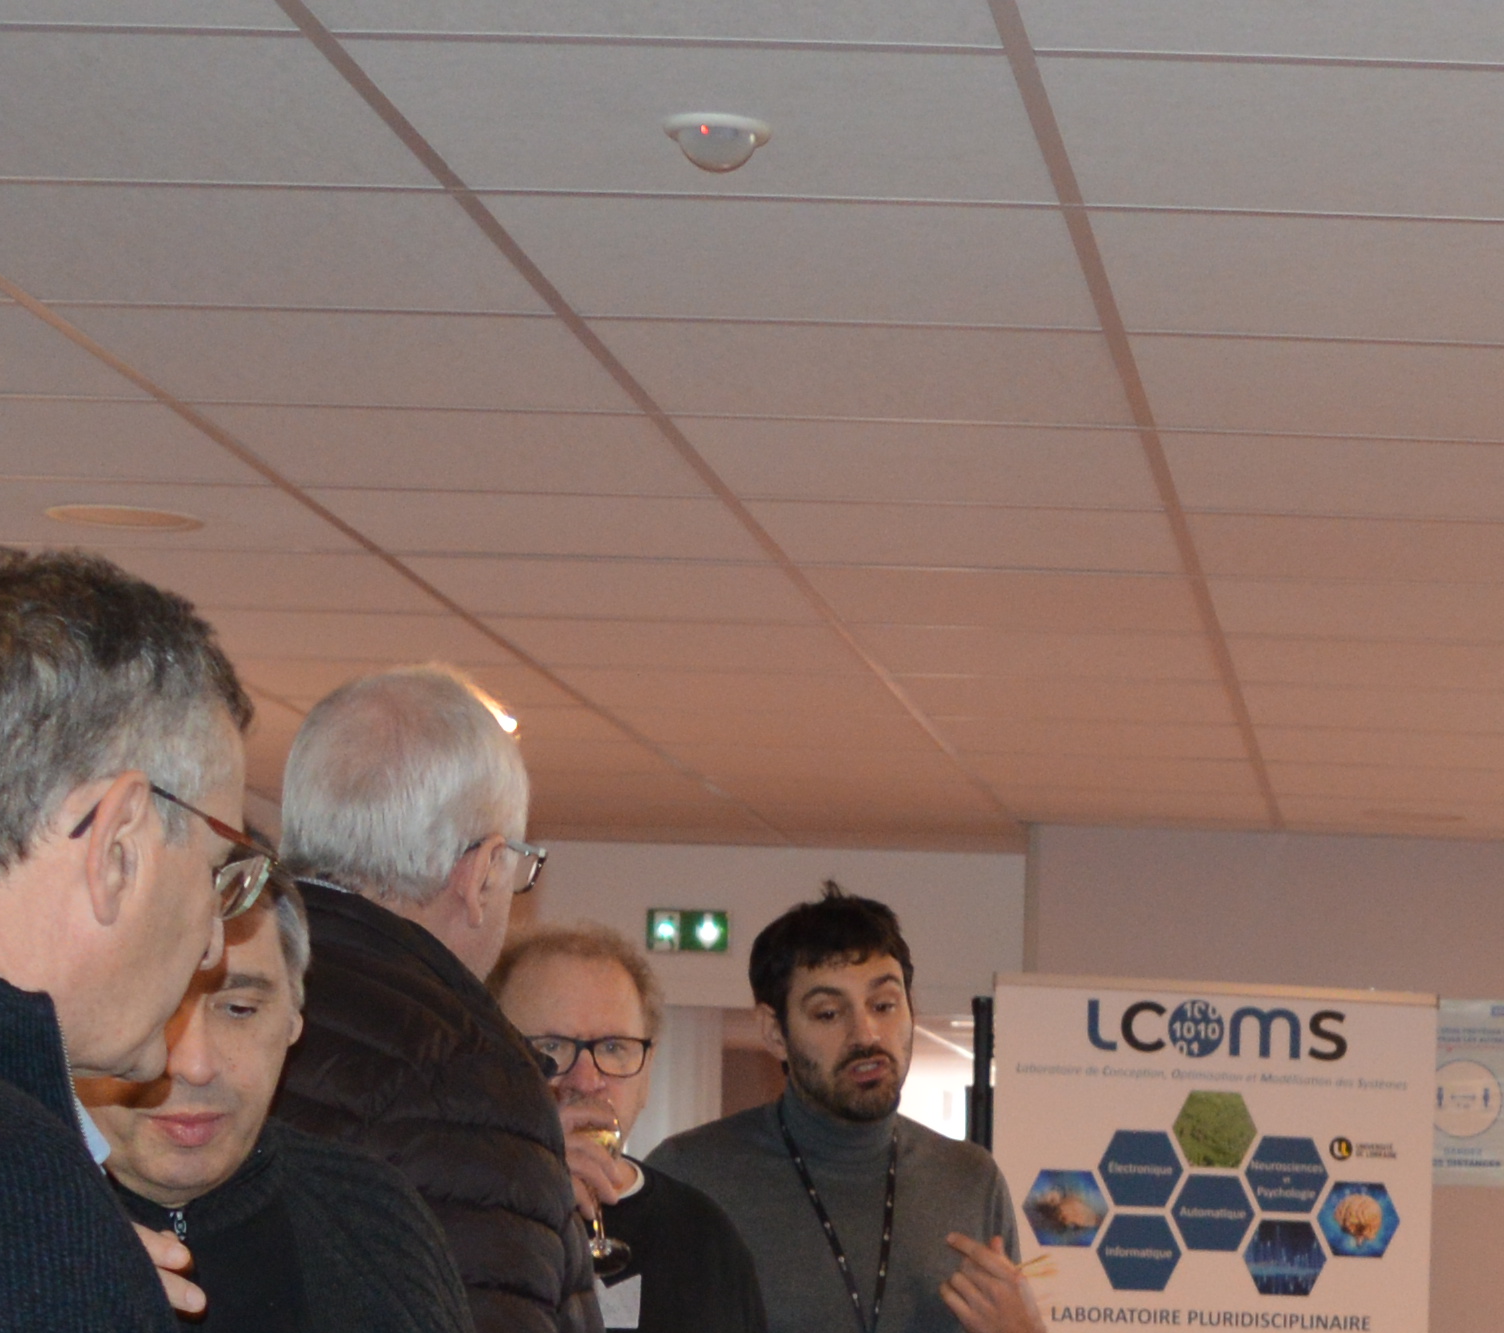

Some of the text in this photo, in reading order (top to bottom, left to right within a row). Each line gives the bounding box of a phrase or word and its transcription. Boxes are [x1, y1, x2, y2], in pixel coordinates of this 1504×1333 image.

[1107, 1161, 1173, 1177] Électronique
[1250, 1160, 1324, 1174] Neurosciences
[1256, 1187, 1316, 1202] Psychologie
[1179, 1205, 1246, 1220] Automatique
[1104, 1245, 1173, 1260] Informatique
[1050, 1305, 1371, 1332] LABORATOIRE PLURIDISCIPLINAIRE
